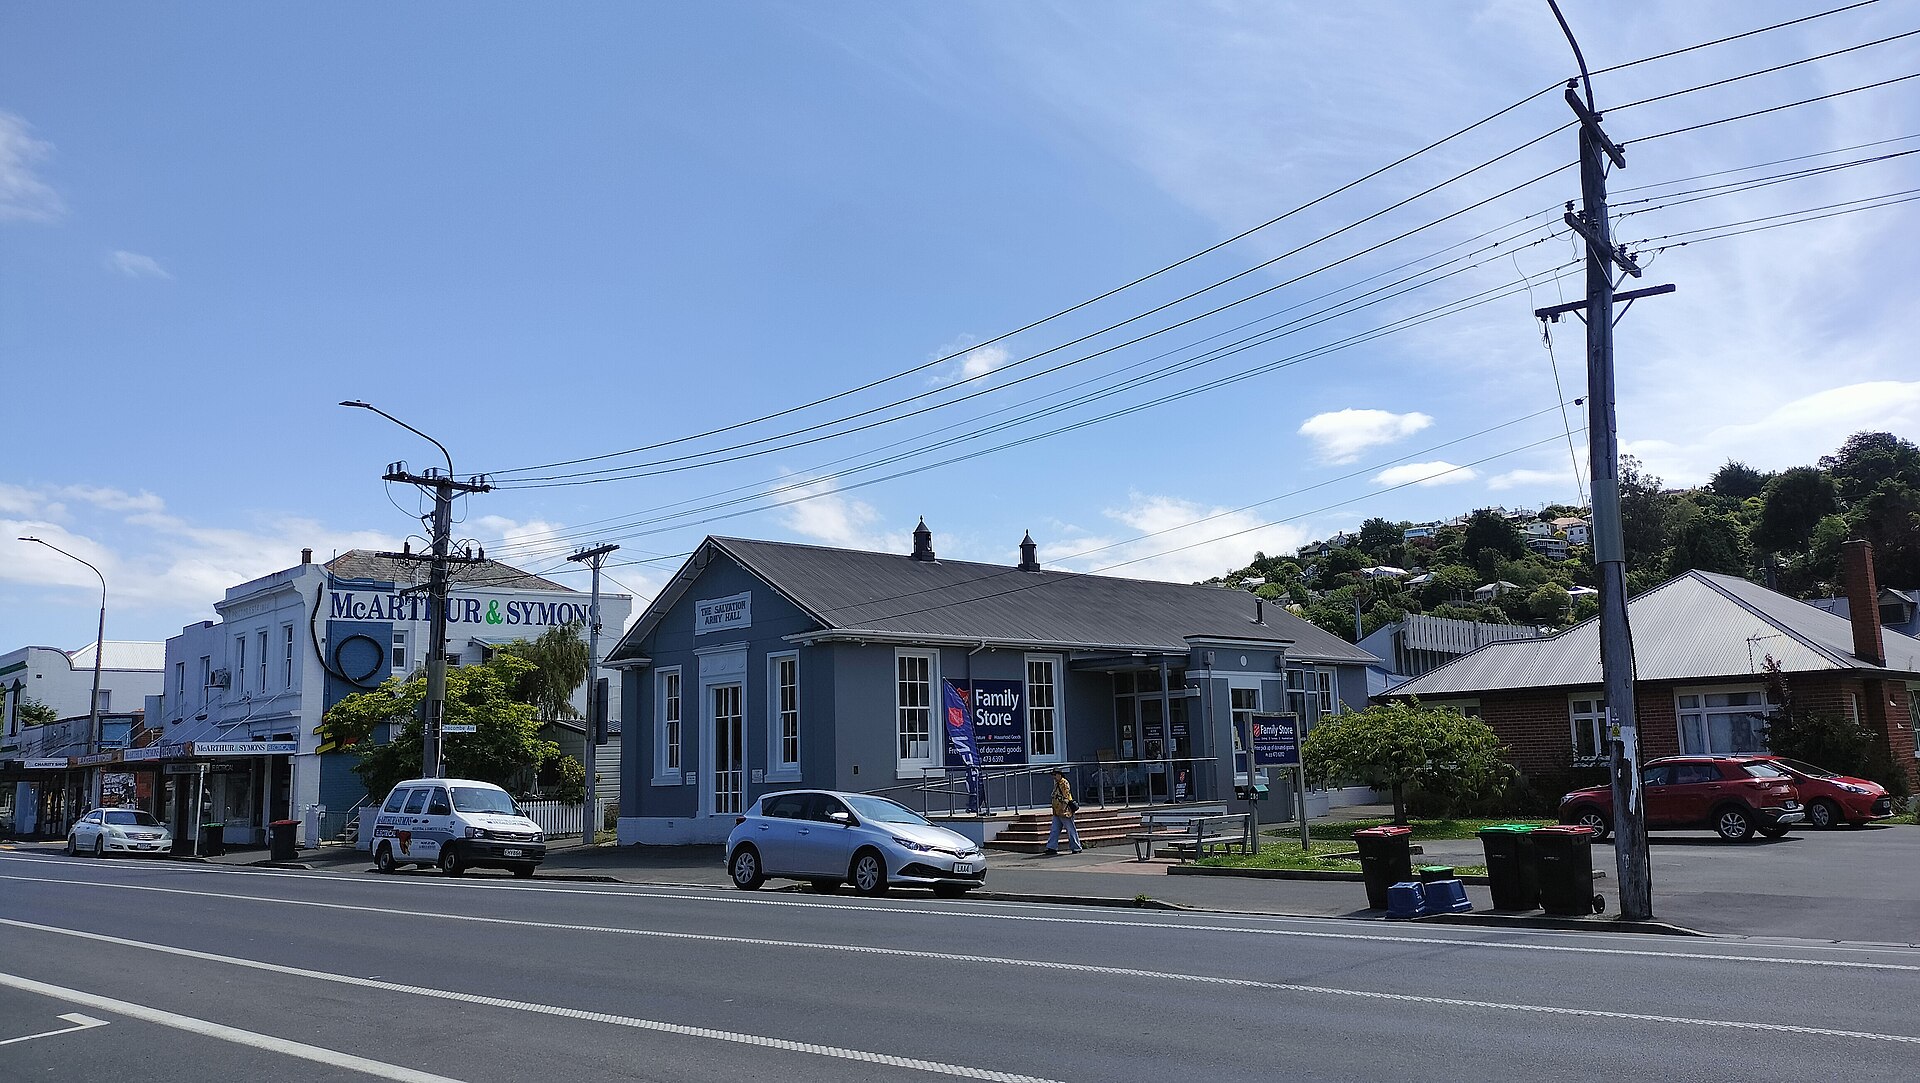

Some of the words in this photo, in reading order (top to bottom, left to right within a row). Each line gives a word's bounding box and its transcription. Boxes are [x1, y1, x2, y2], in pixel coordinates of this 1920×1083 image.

[486, 599, 503, 625] &
[701, 607, 712, 617] THE
[714, 600, 746, 614] SALVATION
[705, 613, 723, 625] ARMY
[725, 611, 741, 622] HALL
[975, 689, 1019, 711] Family
[976, 709, 1011, 726] Store
[1260, 724, 1278, 736] Family
[1279, 724, 1293, 734] Store
[196, 744, 235, 752] McARTHUR
[239, 743, 266, 752] SYMONS
[1006, 746, 1022, 754] goods
